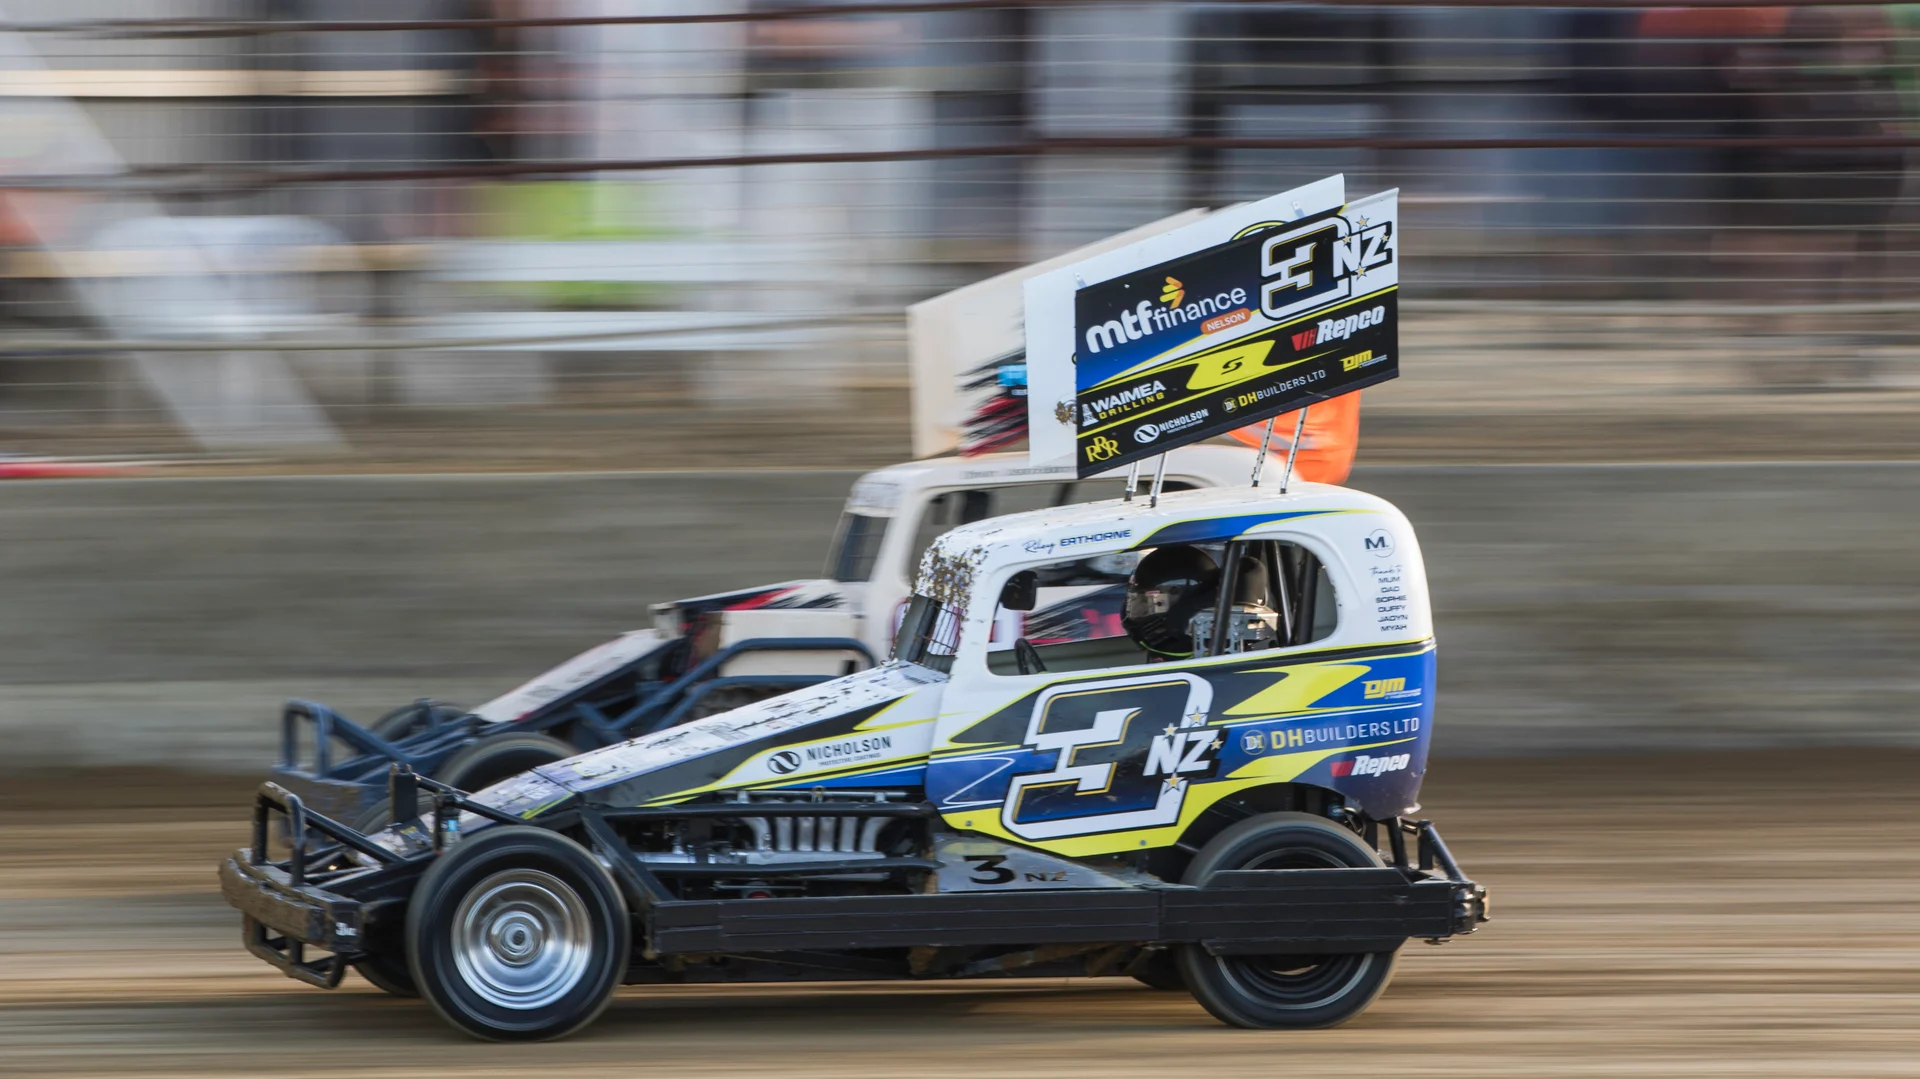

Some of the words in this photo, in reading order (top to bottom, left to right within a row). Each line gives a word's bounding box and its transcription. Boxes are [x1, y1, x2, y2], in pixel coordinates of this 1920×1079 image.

[1332, 223, 1390, 278] NZ
[1206, 312, 1246, 332] NELSON
[1315, 305, 1385, 345] Repco
[1306, 369, 1327, 384] LTD
[1091, 380, 1167, 413] WAIMEA
[1098, 392, 1165, 420] DRILLING
[1159, 408, 1209, 432] NICHOLSON
[1375, 595, 1407, 604] SOPHIE
[1380, 624, 1407, 632] MYAH
[1394, 717, 1420, 734] LTD
[806, 736, 892, 761] NICHOLSON
[1143, 729, 1219, 776] NZ
[1351, 753, 1411, 778] Repco
[962, 854, 1017, 885] 3
